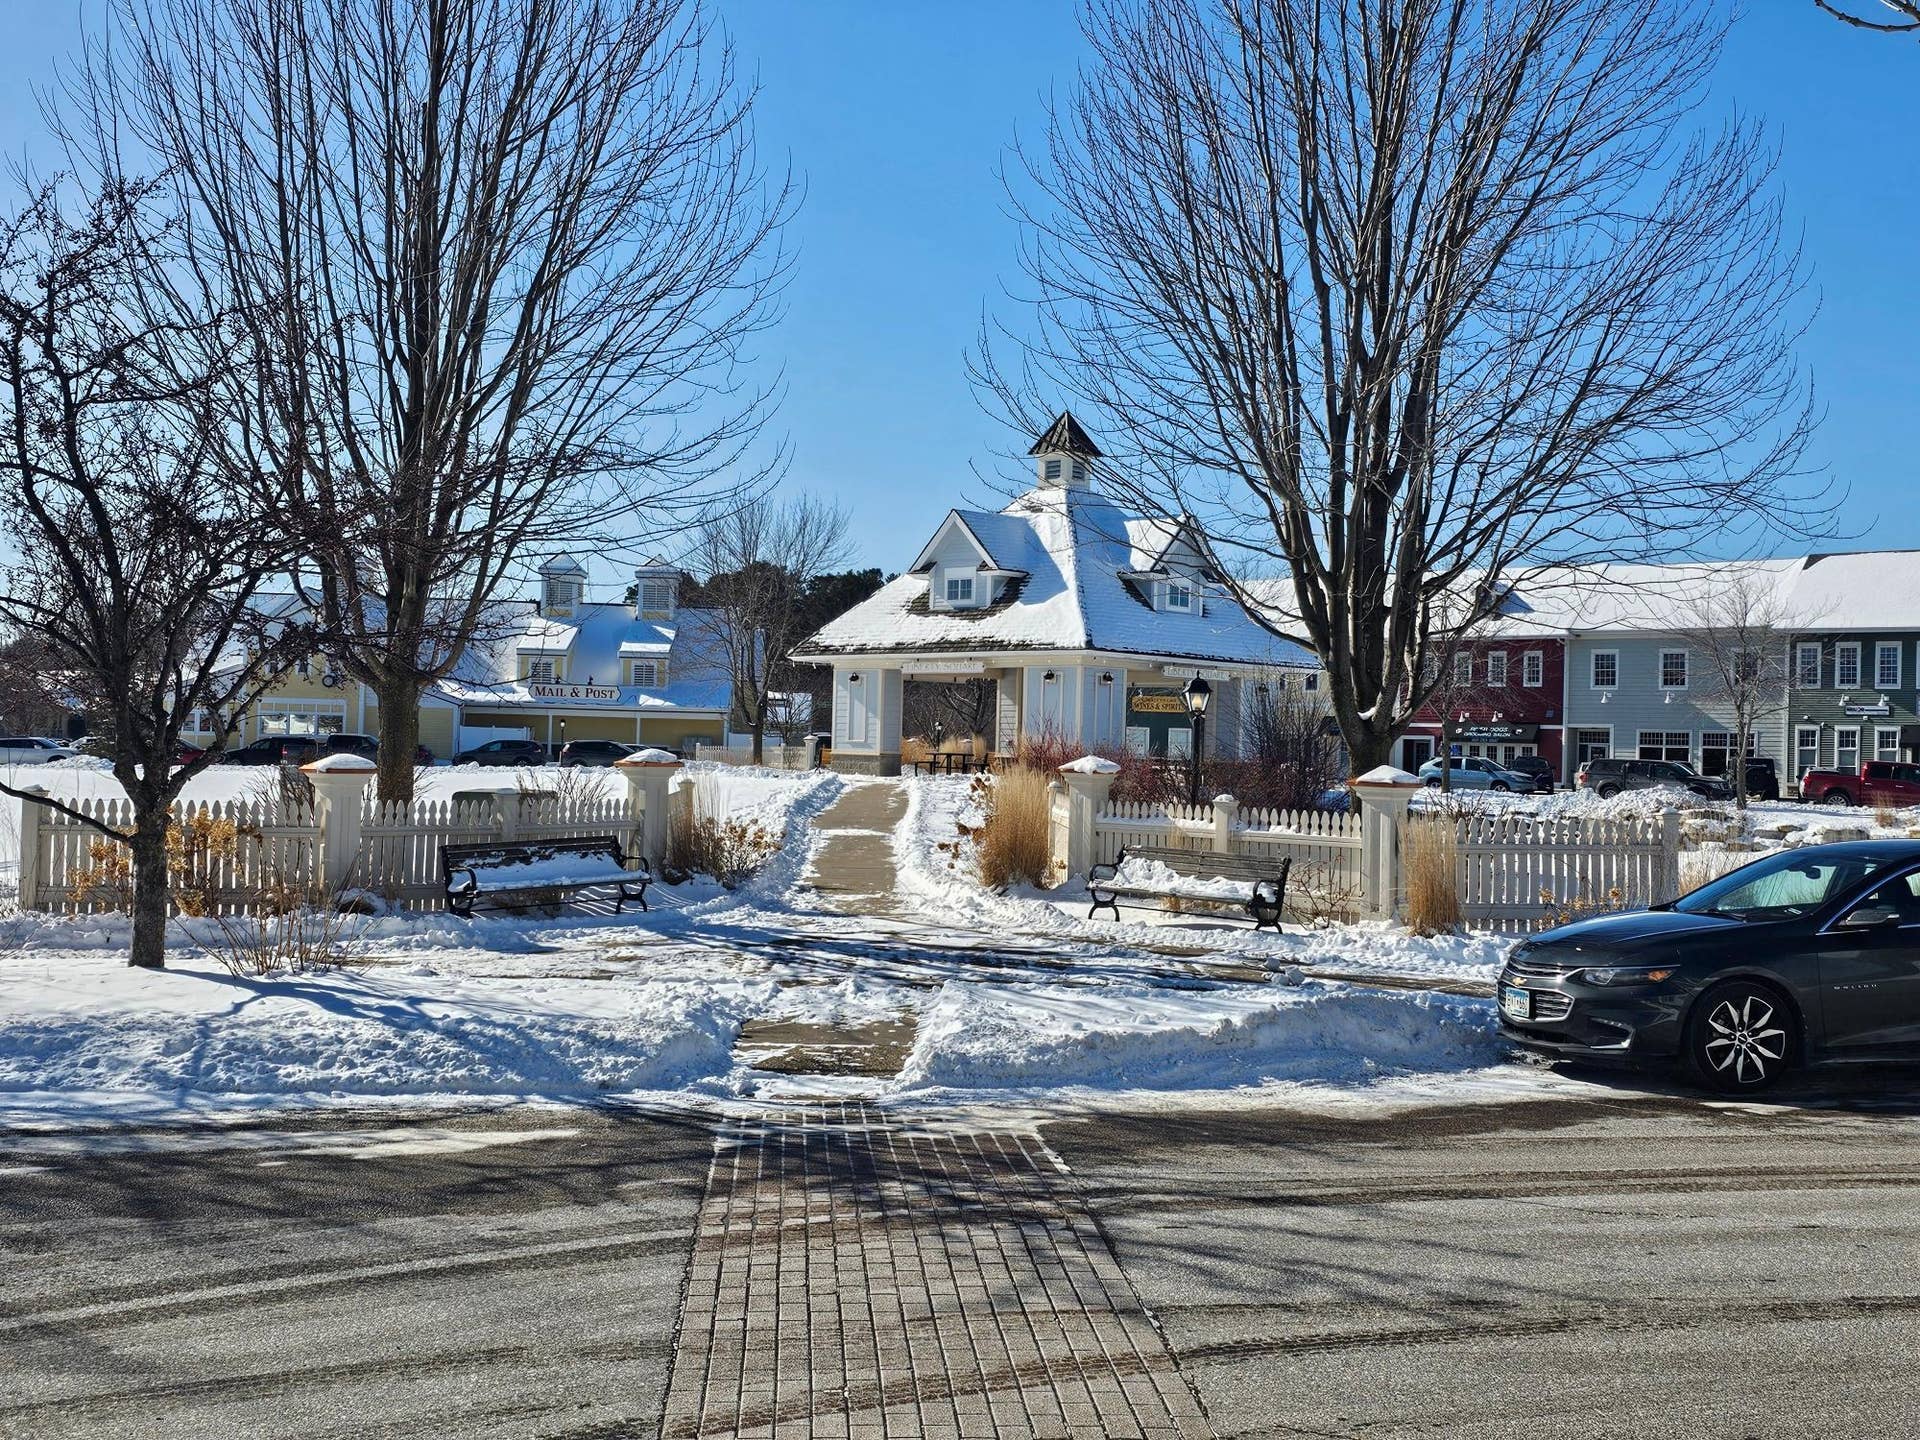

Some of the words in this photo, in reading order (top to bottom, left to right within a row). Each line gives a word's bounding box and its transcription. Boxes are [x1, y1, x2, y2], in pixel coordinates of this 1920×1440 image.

[570, 687, 580, 698] &
[585, 687, 615, 698] POST
[1134, 702, 1154, 710] WINES
